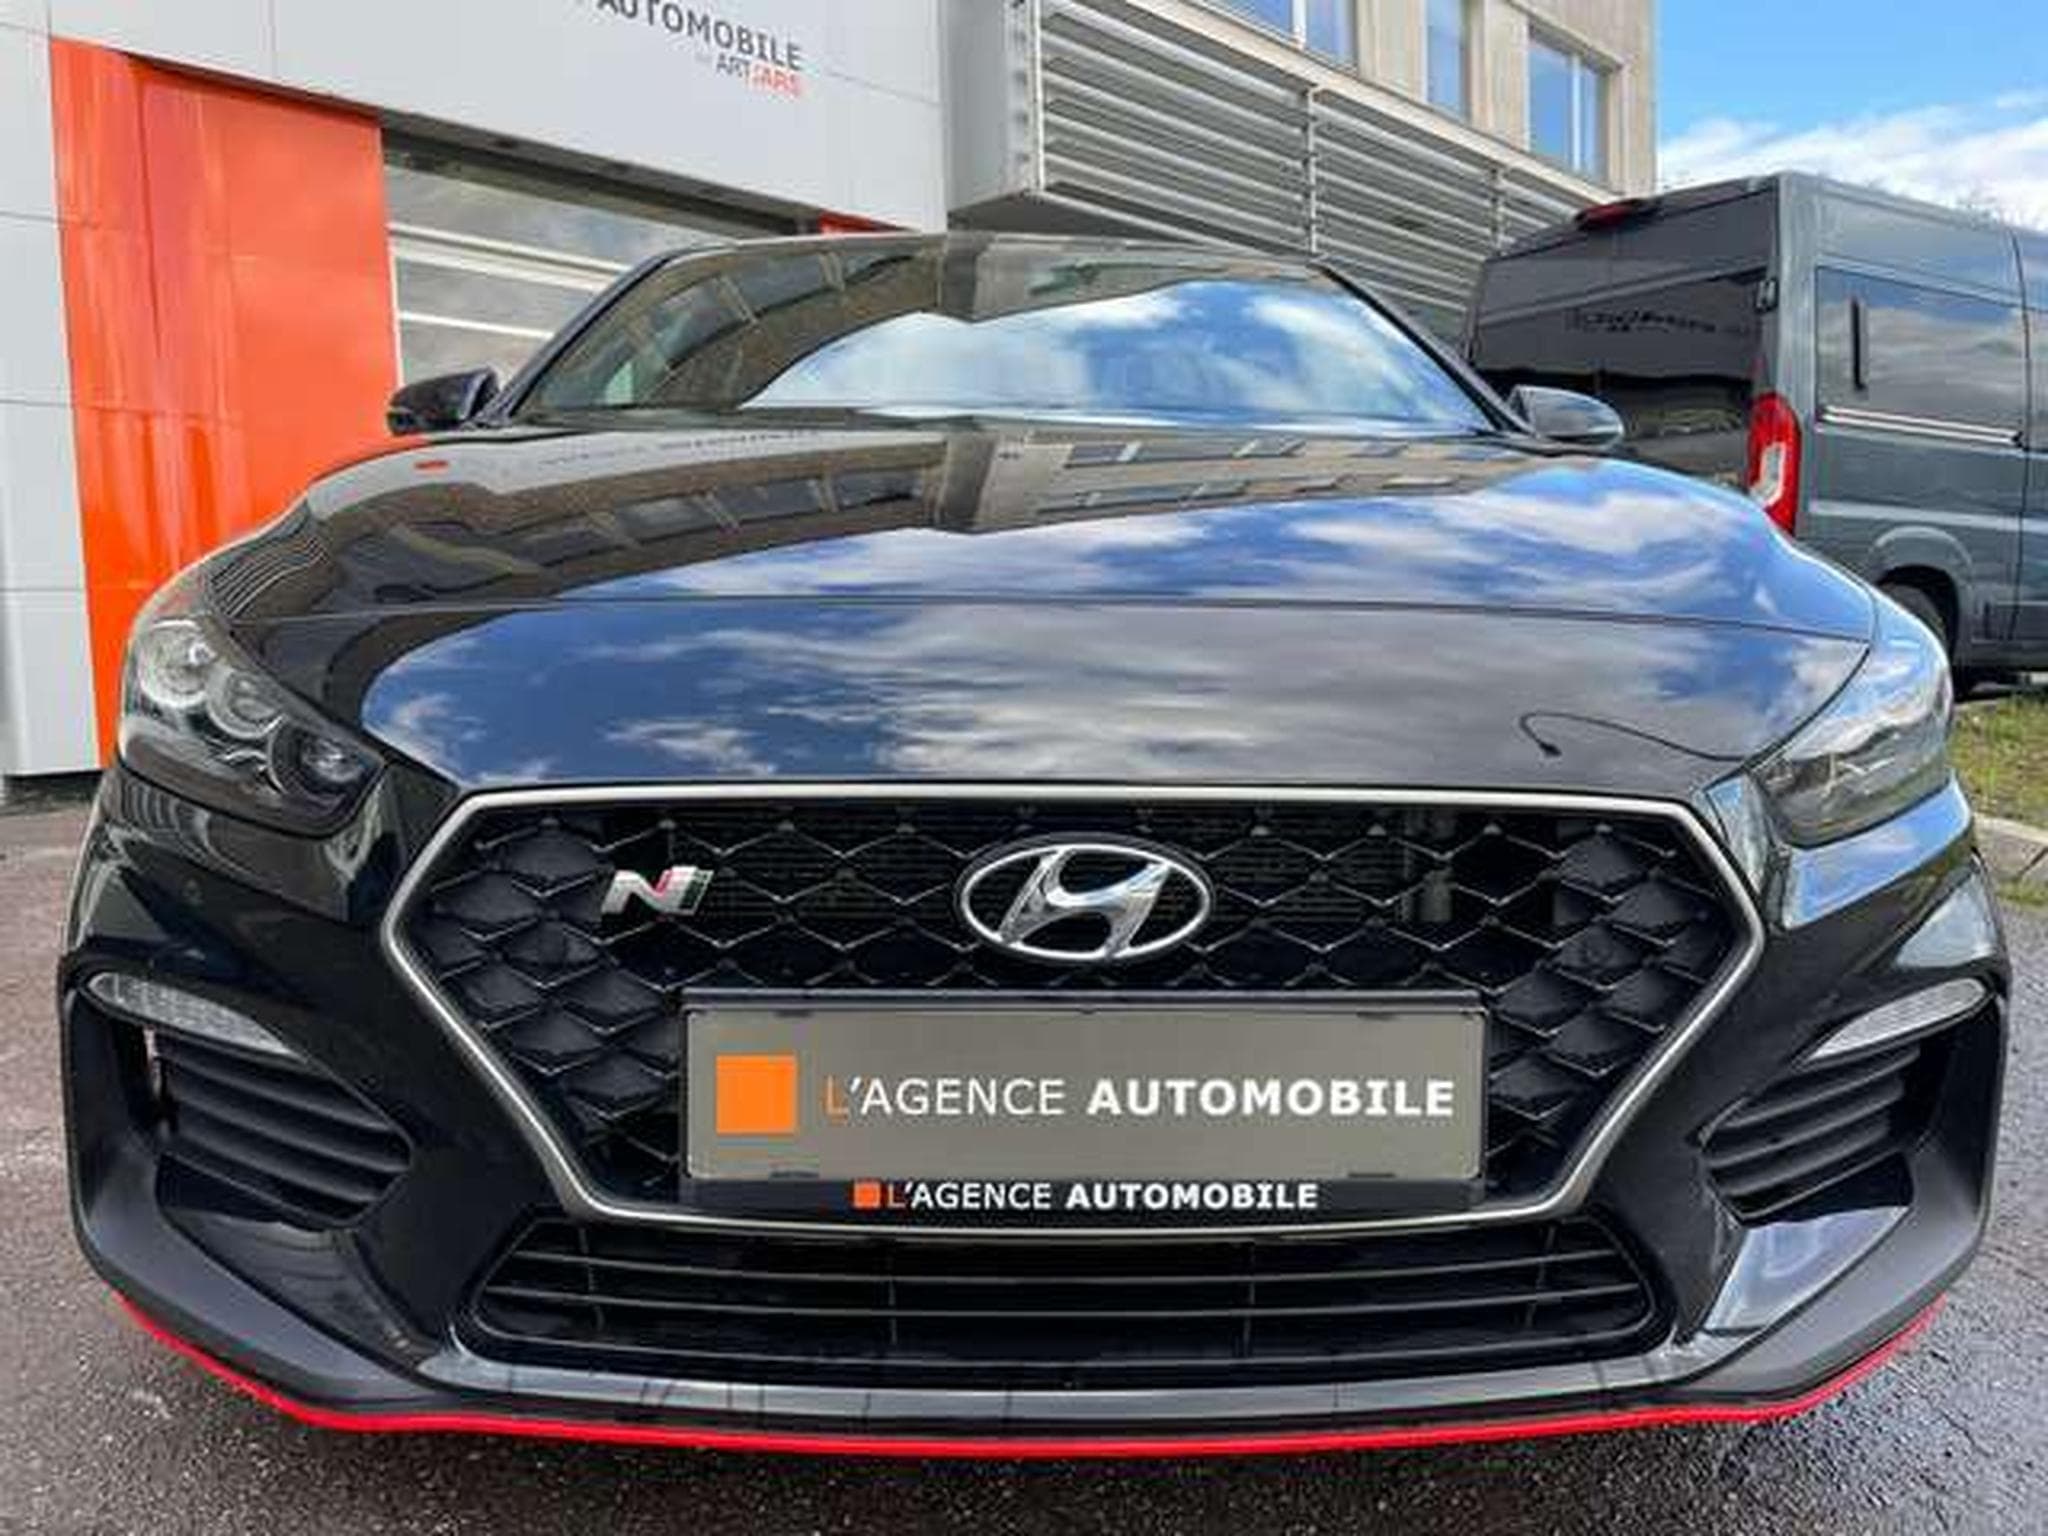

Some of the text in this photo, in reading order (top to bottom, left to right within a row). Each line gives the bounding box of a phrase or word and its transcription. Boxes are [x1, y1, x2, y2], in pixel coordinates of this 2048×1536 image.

[826, 1076, 1455, 1118] L'AGENCE AUTOMOBILE
[887, 1181, 1319, 1210] L'AGENCE AUTOMOBILE
